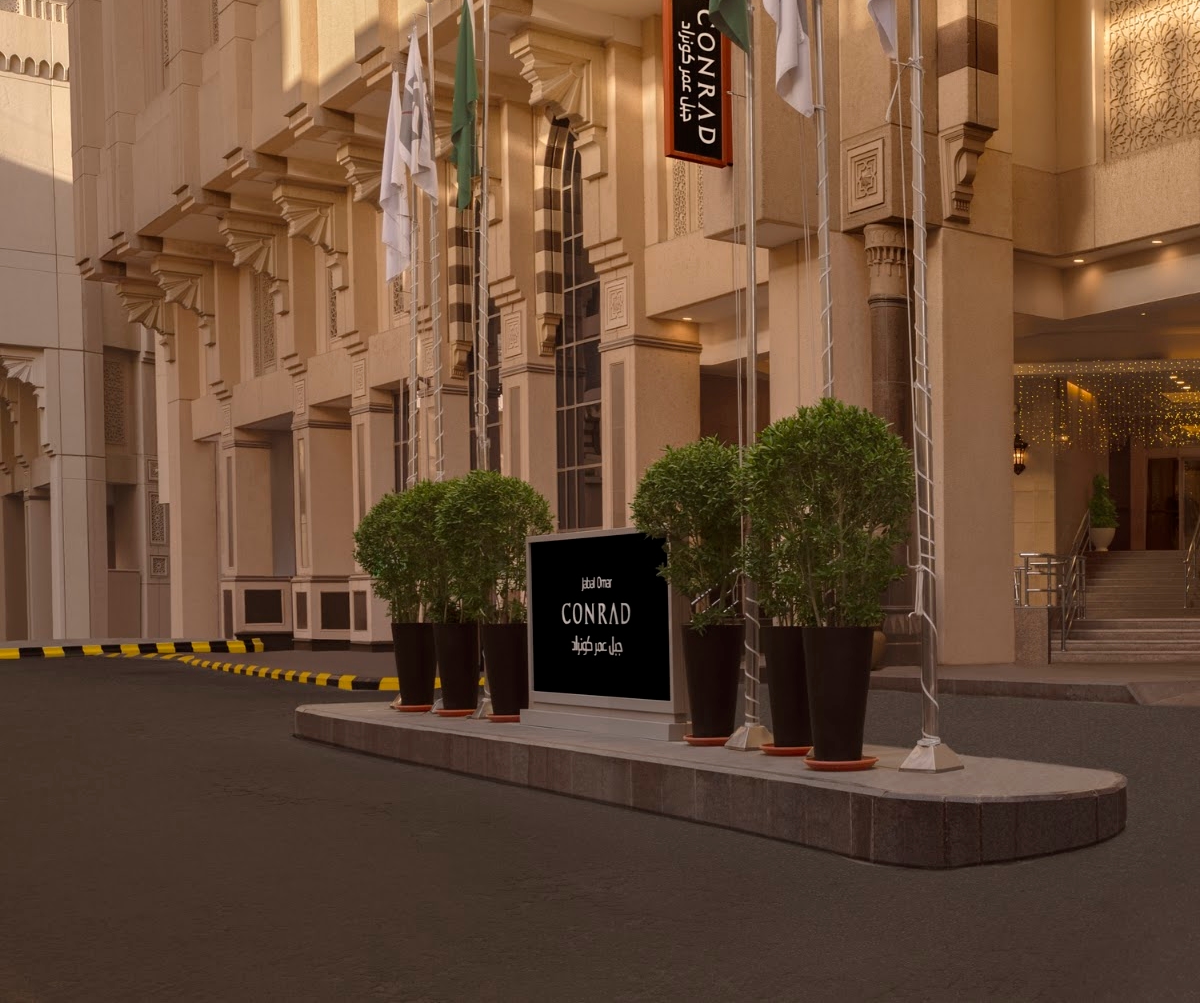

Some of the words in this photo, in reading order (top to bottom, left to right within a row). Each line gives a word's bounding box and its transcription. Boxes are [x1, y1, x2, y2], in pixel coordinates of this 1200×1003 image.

[678, 20, 696, 64] كونراد
[678, 65, 692, 93] عمر
[697, 9, 716, 145] CONRAD
[679, 96, 696, 122] جبل
[581, 577, 596, 592] Jabal
[597, 576, 613, 589] Omar
[561, 602, 631, 625] CONRAD
[571, 635, 593, 656] كونراد
[593, 641, 608, 656] عمر
[608, 636, 623, 656] جبل
